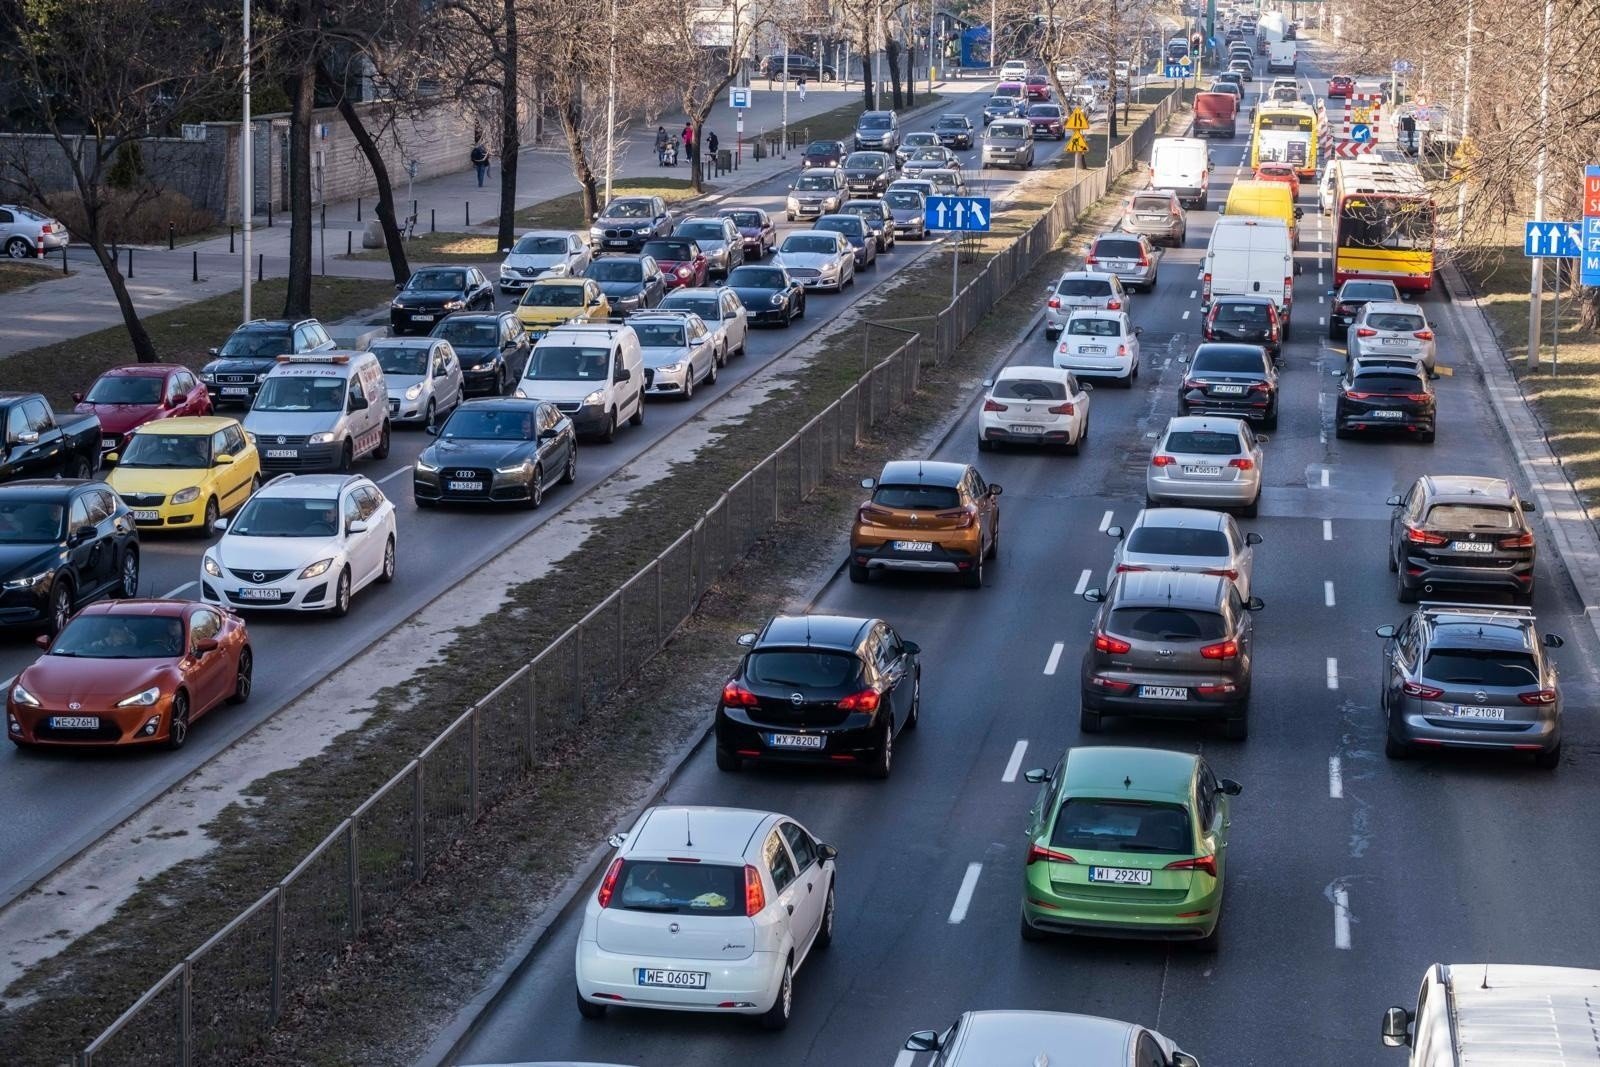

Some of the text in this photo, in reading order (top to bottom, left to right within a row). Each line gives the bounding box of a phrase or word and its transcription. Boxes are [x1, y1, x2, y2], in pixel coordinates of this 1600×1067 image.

[1456, 542, 1466, 550] GD
[1144, 686, 1186, 697] WW 177WX
[1460, 707, 1503, 718] WF 2108V
[55, 718, 68, 727] WE
[775, 735, 819, 746] WX 7820C
[1097, 868, 1149, 882] WI 292KU
[646, 970, 704, 986] WE 0605T
